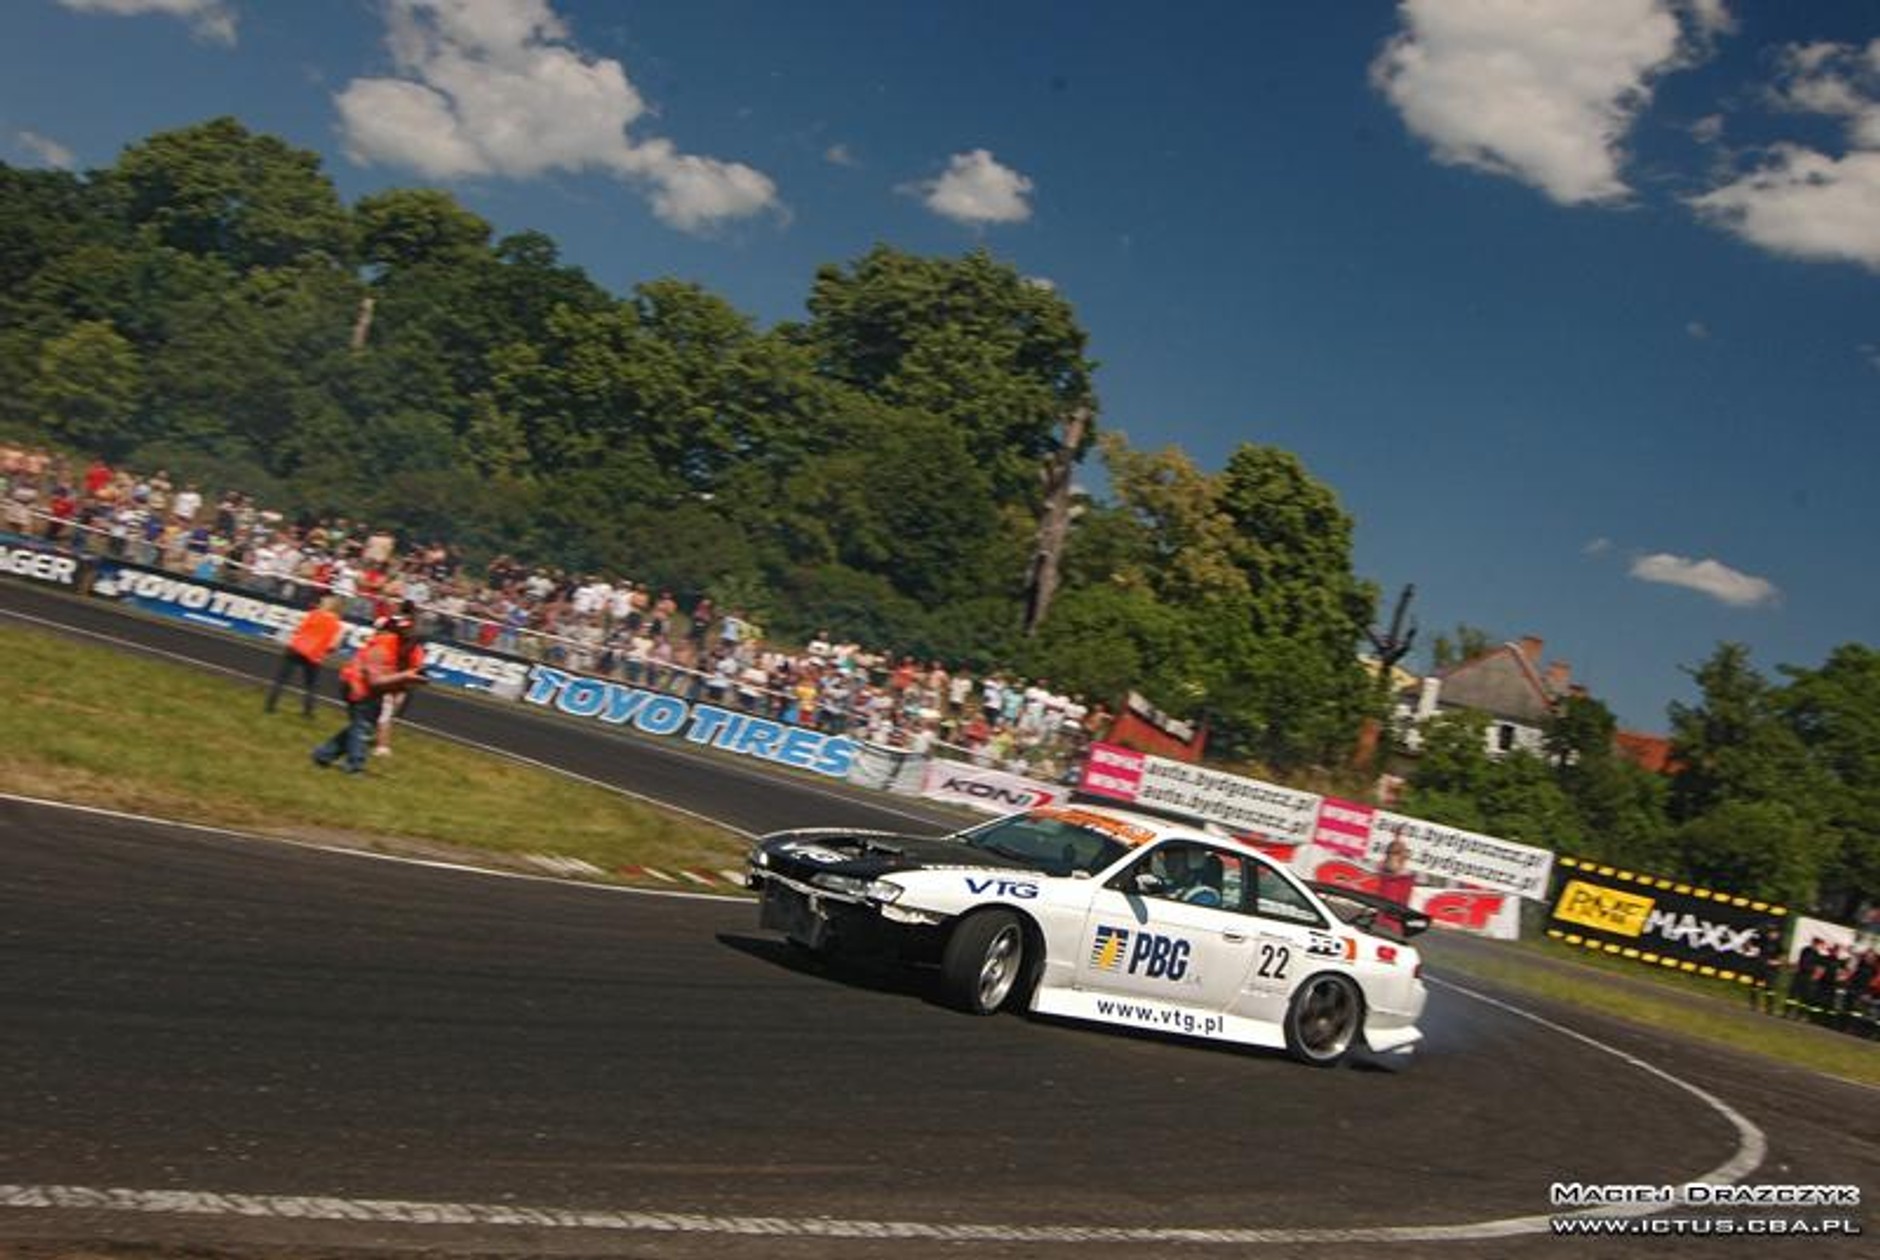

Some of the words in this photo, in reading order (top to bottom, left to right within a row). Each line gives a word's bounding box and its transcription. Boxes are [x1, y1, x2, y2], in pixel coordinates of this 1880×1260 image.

[117, 569, 212, 608] TOYO
[525, 663, 686, 735] TOYO
[685, 703, 864, 778] TIRES
[964, 877, 1040, 899] VTG
[1128, 931, 1190, 981] PBG
[1257, 944, 1289, 979] 22
[1097, 999, 1223, 1035] www.vtg.pl
